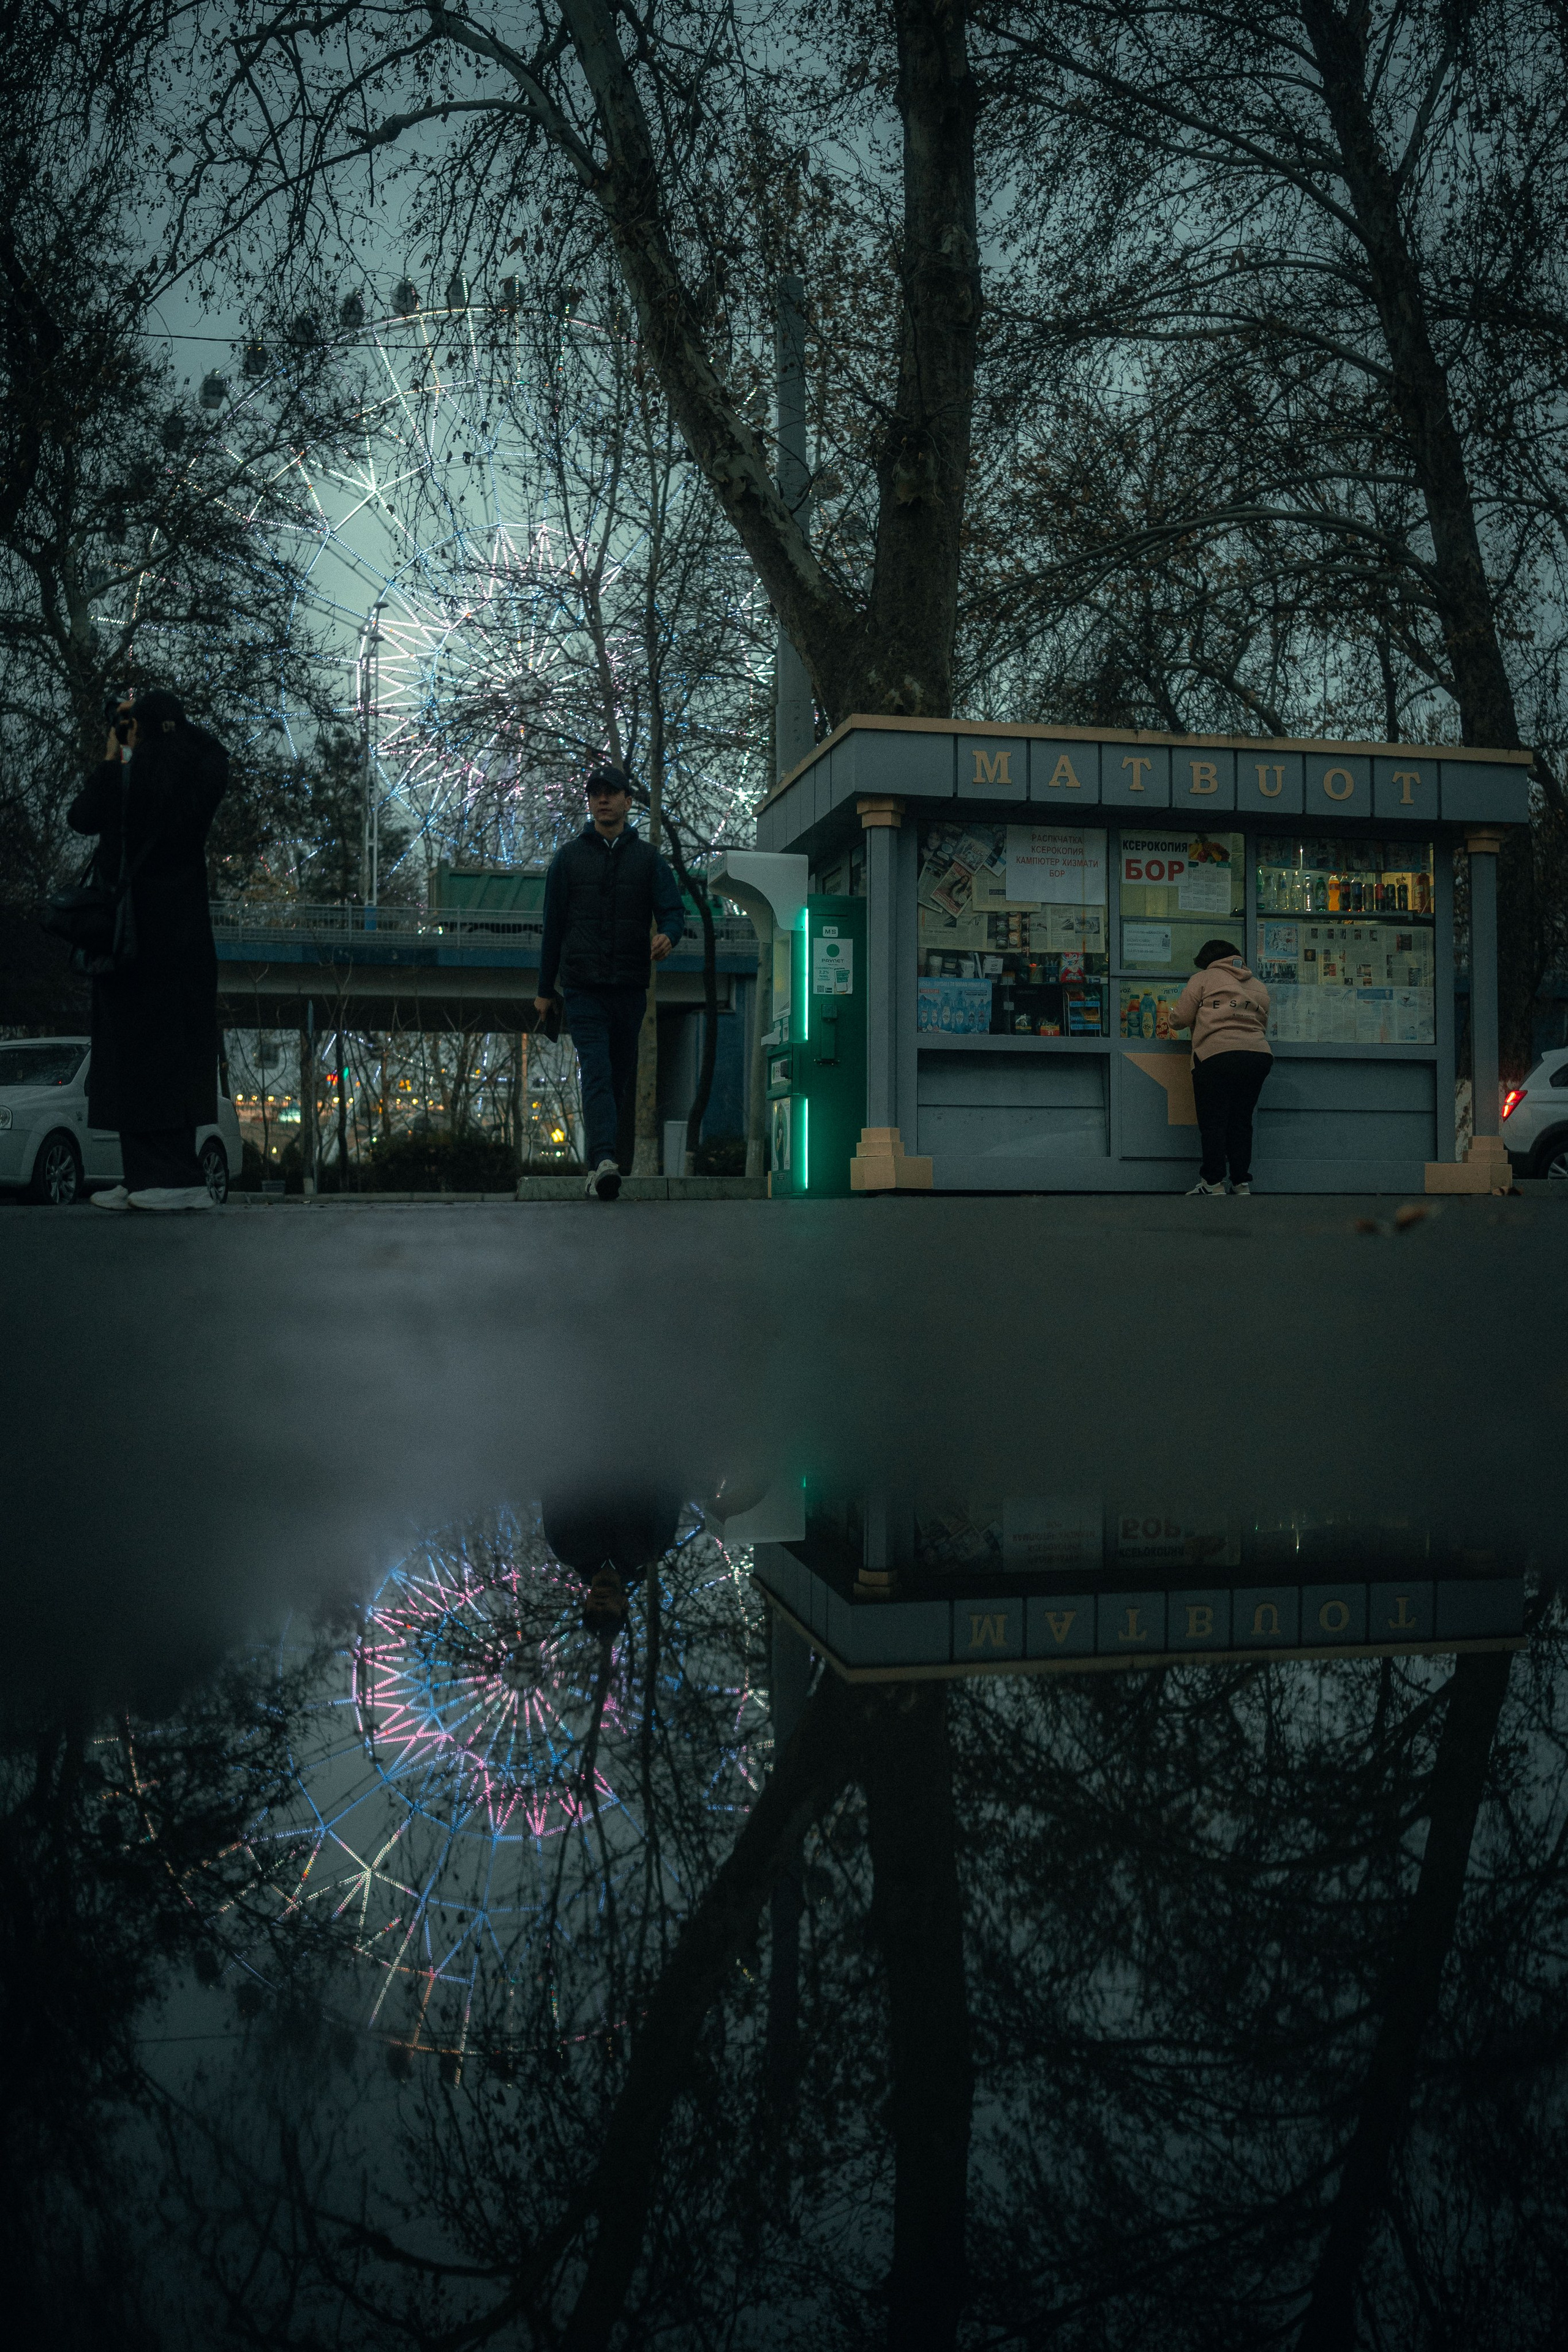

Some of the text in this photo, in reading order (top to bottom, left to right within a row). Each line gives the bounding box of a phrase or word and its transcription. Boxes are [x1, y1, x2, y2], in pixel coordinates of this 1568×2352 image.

[972, 750, 1422, 804] MATBUOT
[1031, 834, 1083, 844] РАСПКЧАТКА
[1031, 846, 1084, 855] КСЕРОКОПИЯ
[1123, 840, 1188, 853] КСЕРОКОПИЯ
[1016, 856, 1098, 867] КАМПЮТЕР ХИЗМАТИ
[1049, 869, 1065, 878] БОР
[1125, 859, 1185, 881] БОР
